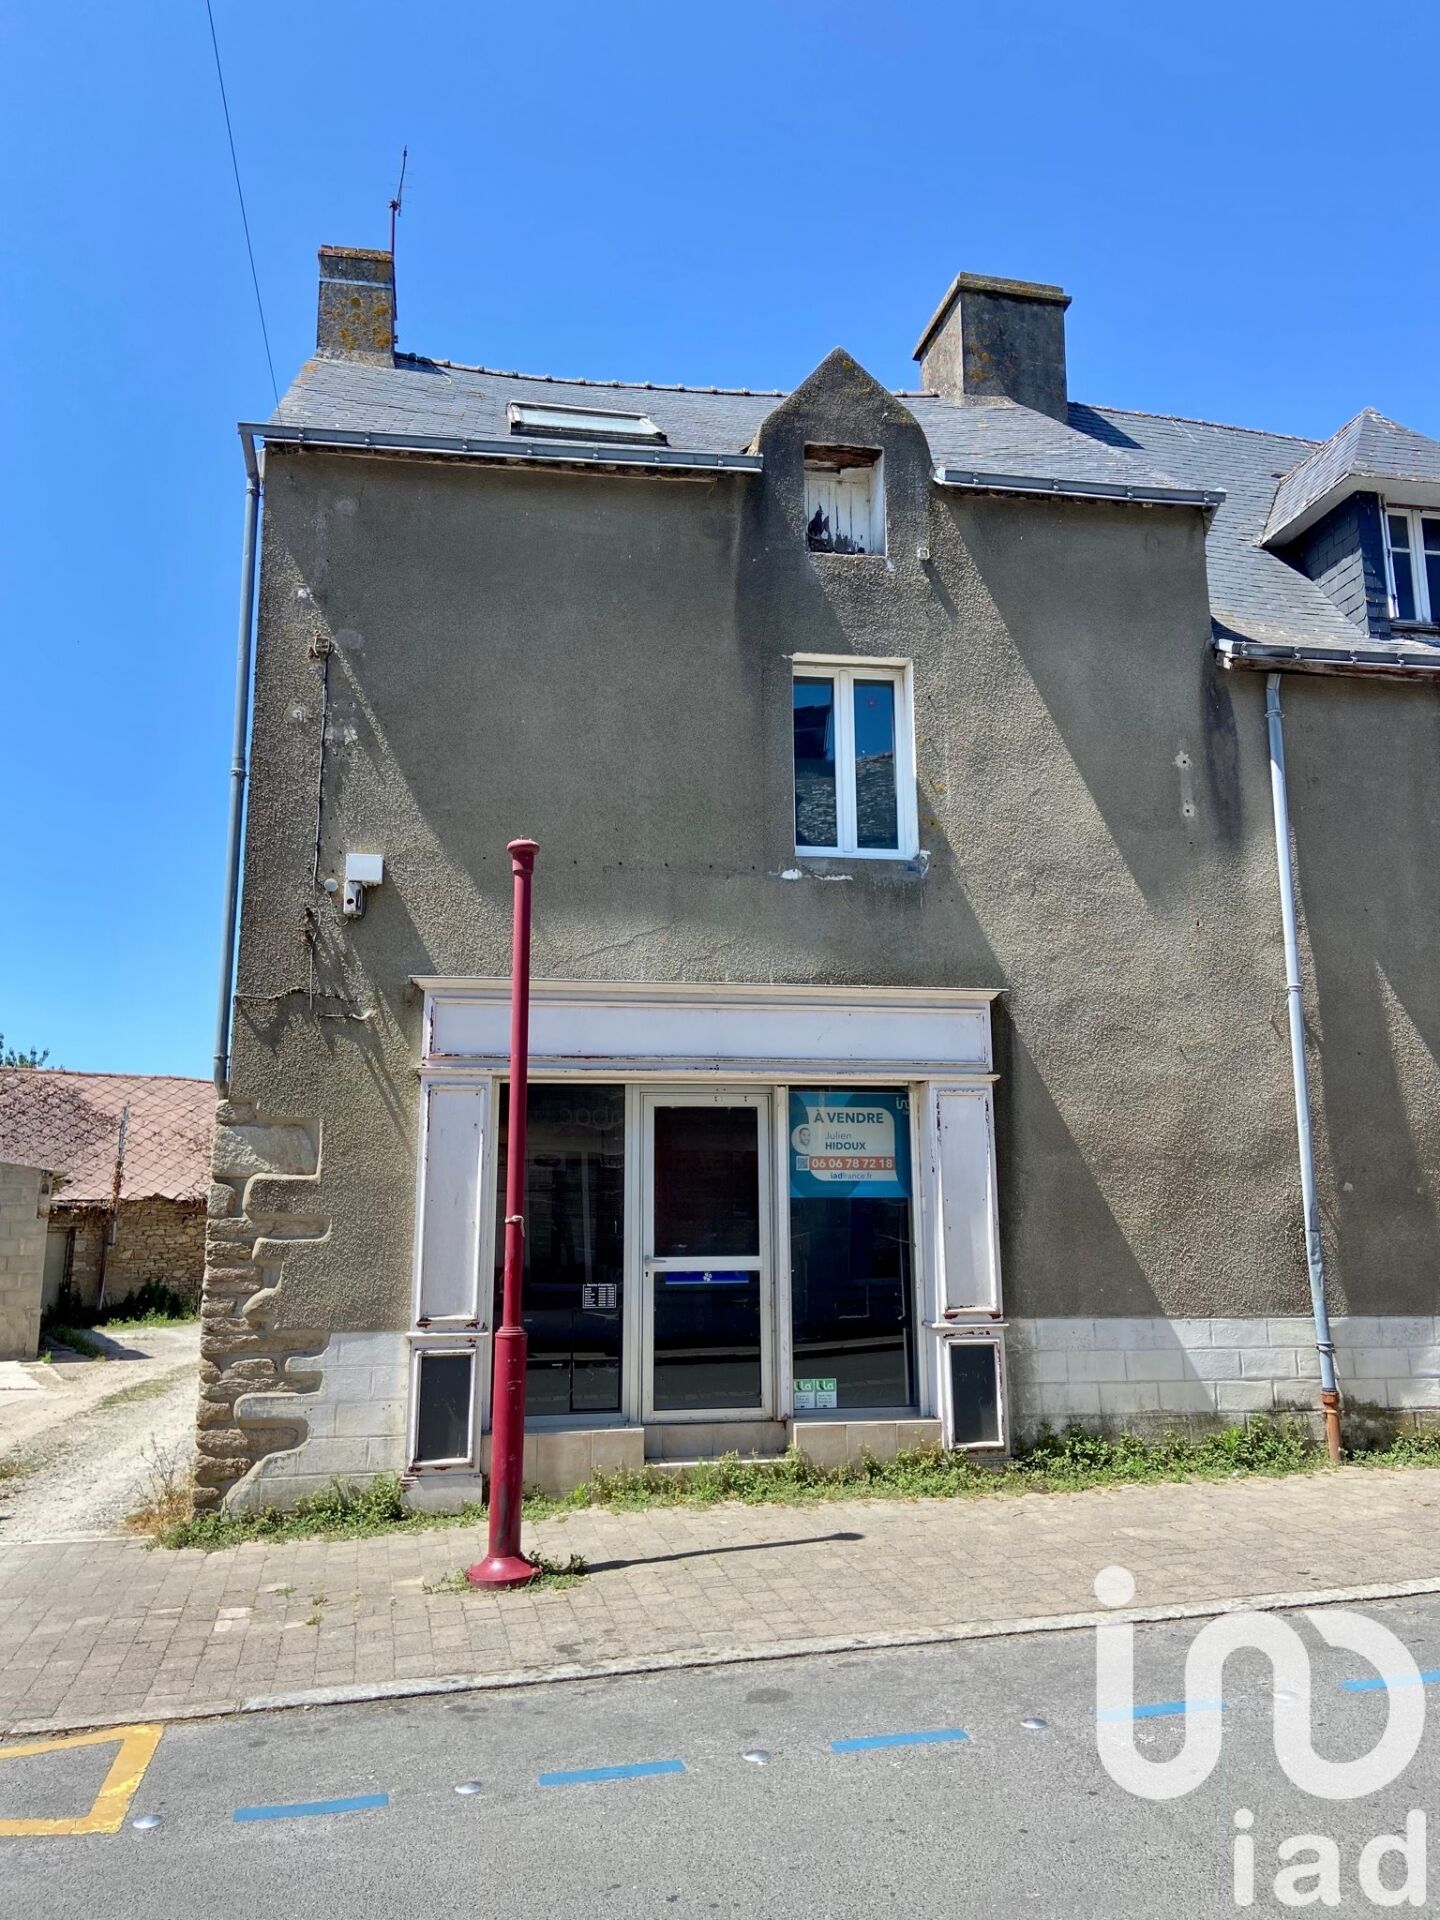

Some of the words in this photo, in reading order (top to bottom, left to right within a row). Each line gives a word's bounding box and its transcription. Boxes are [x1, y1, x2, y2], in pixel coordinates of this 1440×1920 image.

[814, 1109, 825, 1123] À
[827, 1112, 884, 1124] VENDRE
[825, 1131, 852, 1140] Julien
[825, 1142, 866, 1150] HIDOUX
[812, 1159, 826, 1168] 06
[828, 1159, 843, 1168] 06
[846, 1159, 860, 1168] 78
[862, 1159, 876, 1168] 72
[879, 1159, 893, 1168] 18
